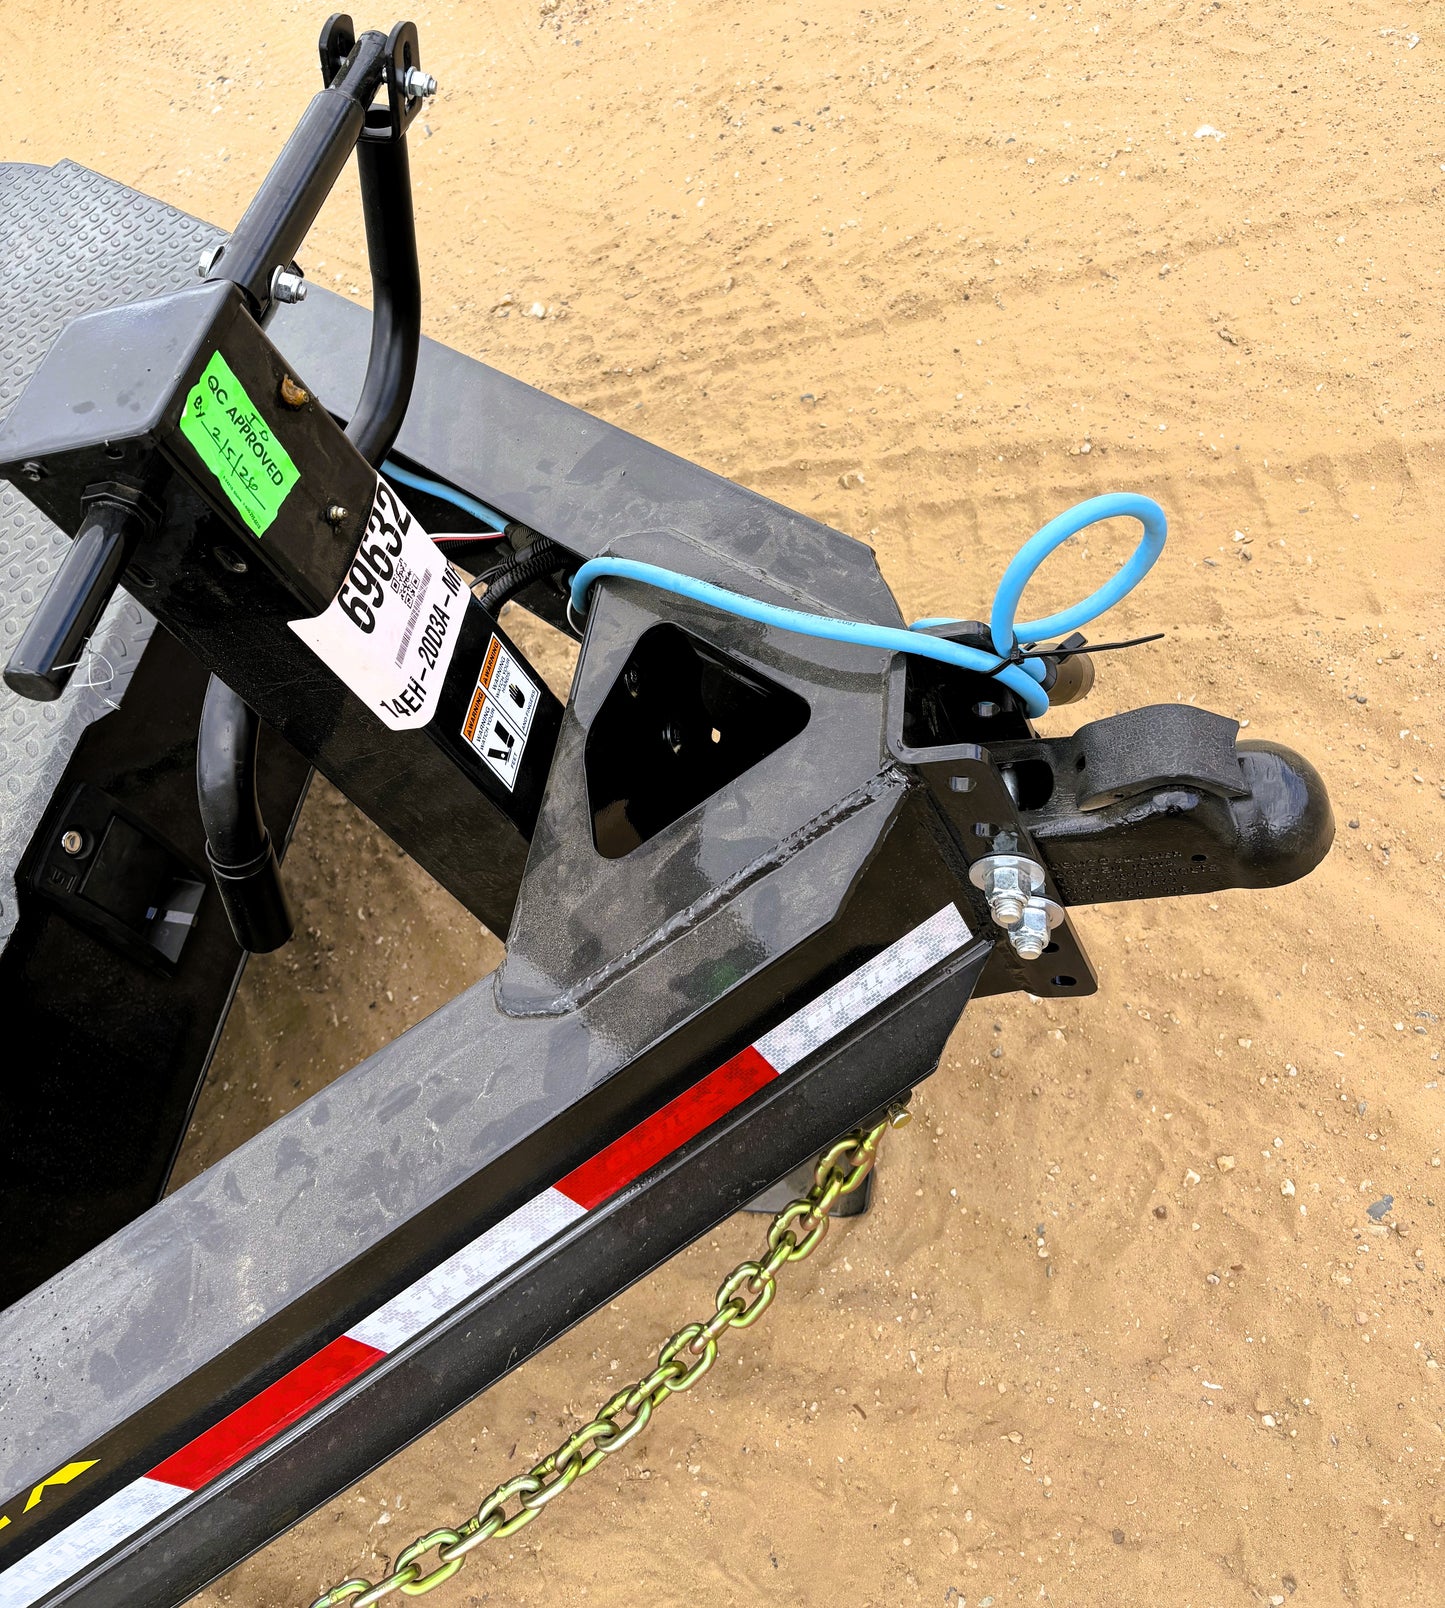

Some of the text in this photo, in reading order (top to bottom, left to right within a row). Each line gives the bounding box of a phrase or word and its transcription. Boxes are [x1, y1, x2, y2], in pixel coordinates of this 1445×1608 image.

[207, 375, 229, 405] QC
[225, 407, 284, 486] APPROVED
[337, 481, 412, 634] 69632
[485, 642, 499, 678] WARNING
[491, 656, 506, 691] WARNING
[495, 658, 511, 699] WATCH YOUR
[468, 692, 484, 729] WARNING
[526, 690, 536, 717] FINGERS
[476, 706, 490, 742] WARNING
[480, 707, 496, 750] WATCH YOUR
